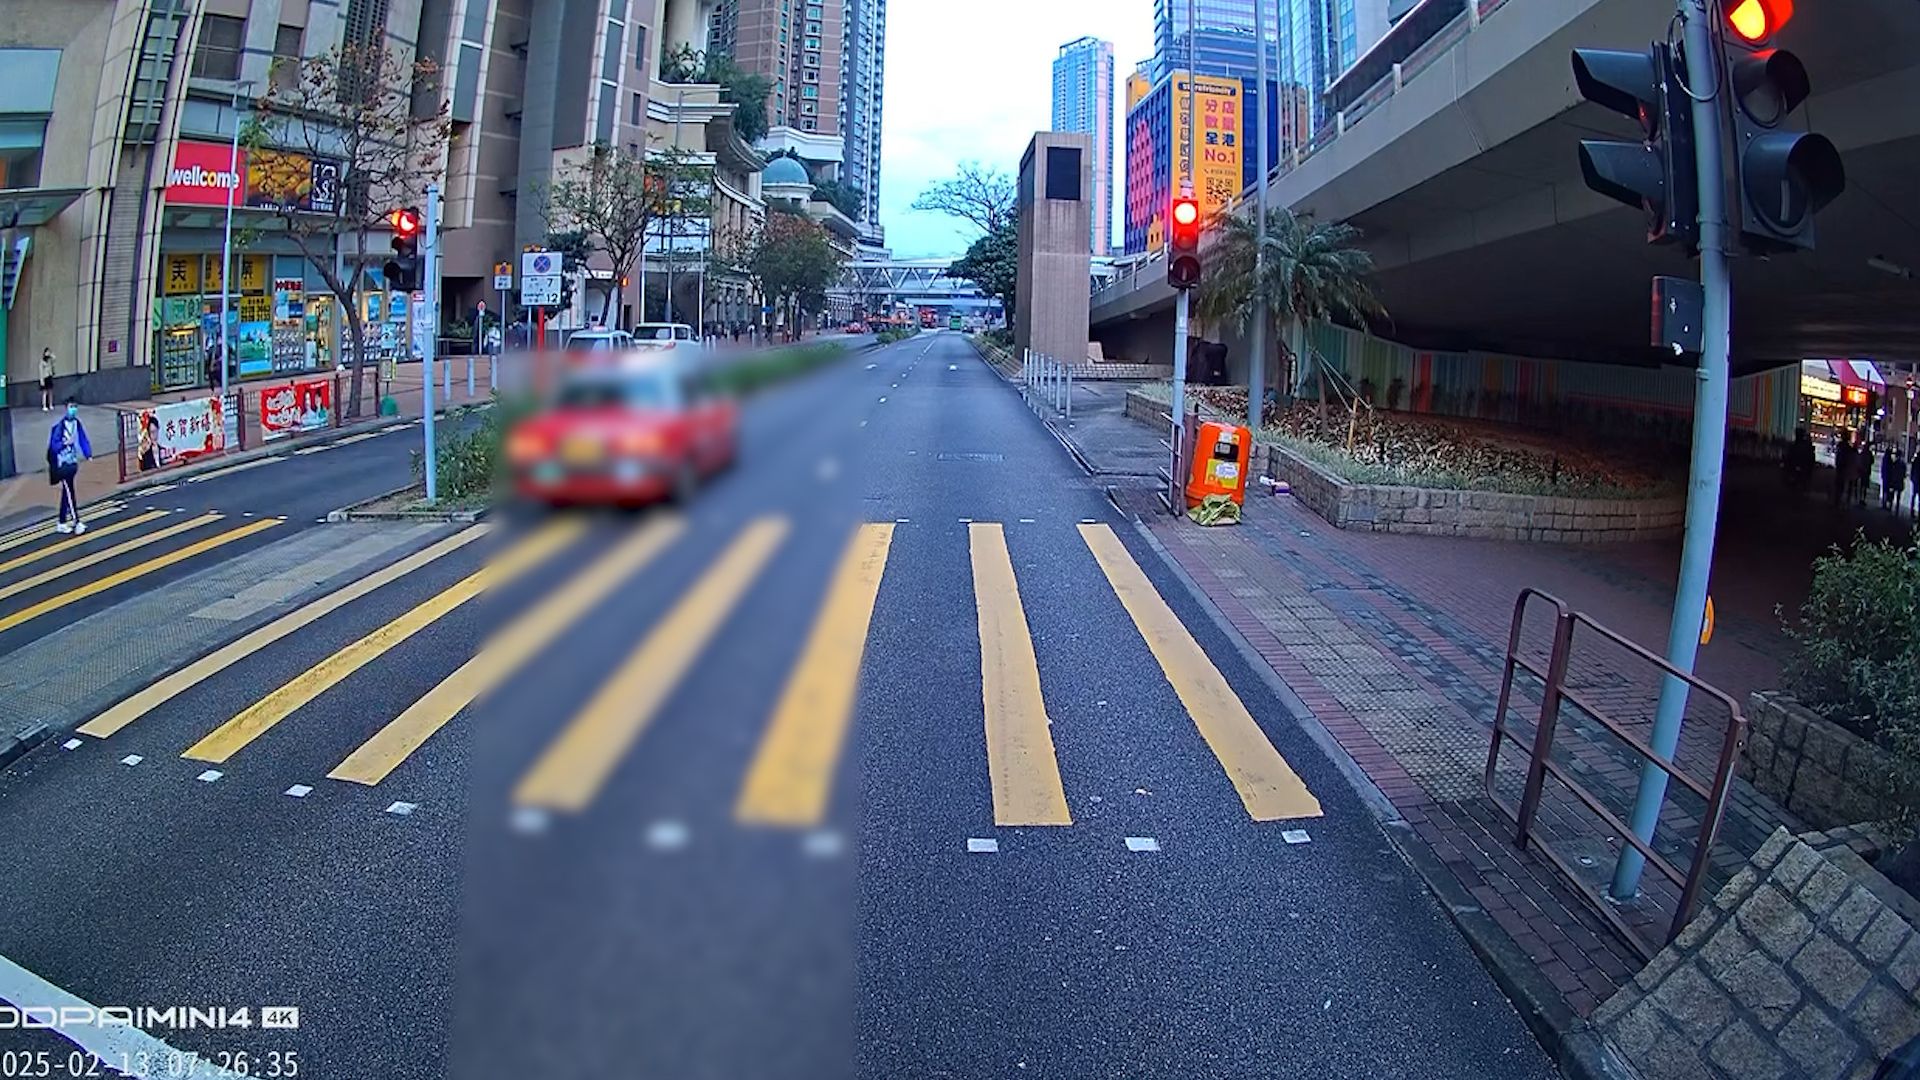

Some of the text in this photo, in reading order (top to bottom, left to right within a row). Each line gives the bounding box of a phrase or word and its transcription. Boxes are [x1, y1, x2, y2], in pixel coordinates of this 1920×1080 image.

[1205, 148, 1235, 164] No.1
[171, 165, 240, 189] wellcome
[547, 278, 554, 288] 7
[546, 293, 558, 303] 12
